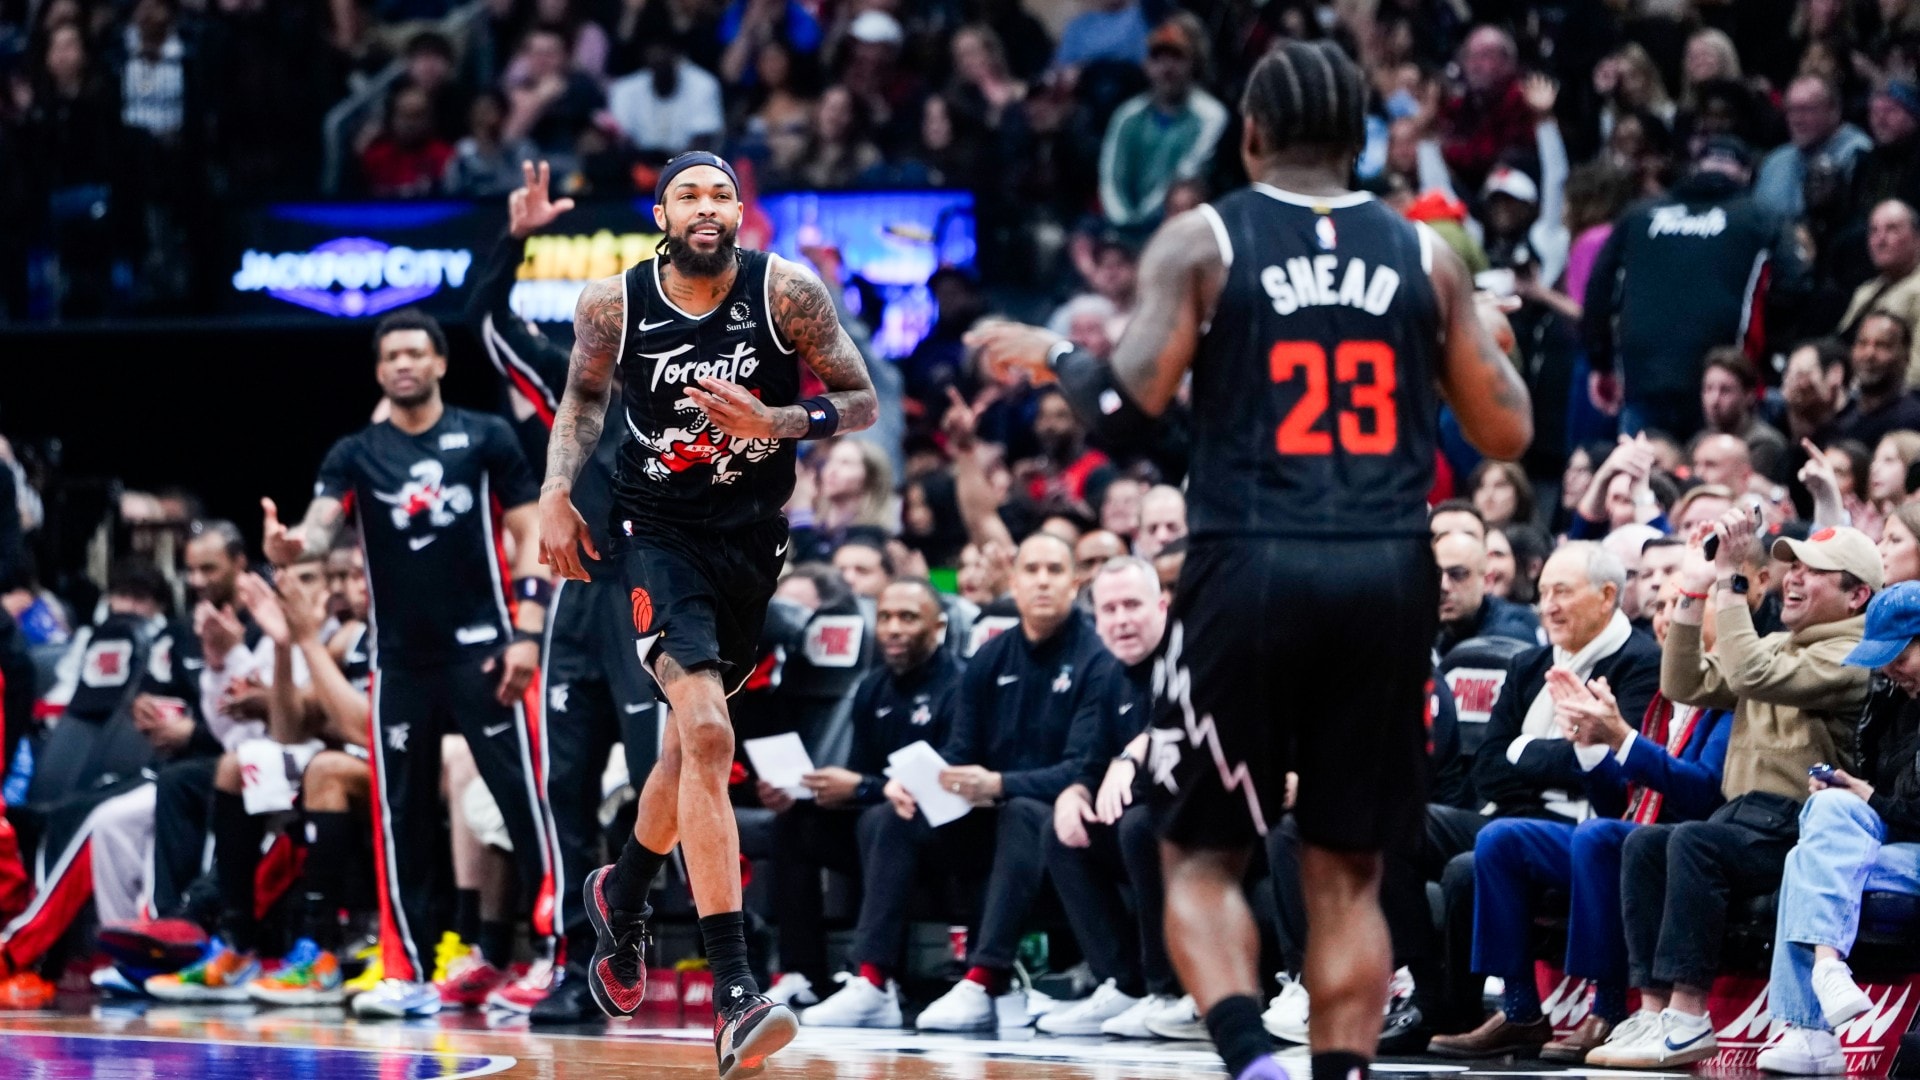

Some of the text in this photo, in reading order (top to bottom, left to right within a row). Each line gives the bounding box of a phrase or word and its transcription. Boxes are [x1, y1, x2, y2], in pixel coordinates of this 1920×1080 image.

[1260, 254, 1400, 316] SHEAD
[742, 320, 757, 329] Life
[637, 342, 759, 392] Toronto
[1269, 340, 1398, 455] 23
[1453, 678, 1497, 712] PRIME
[1697, 1048, 1757, 1067] AGELL
